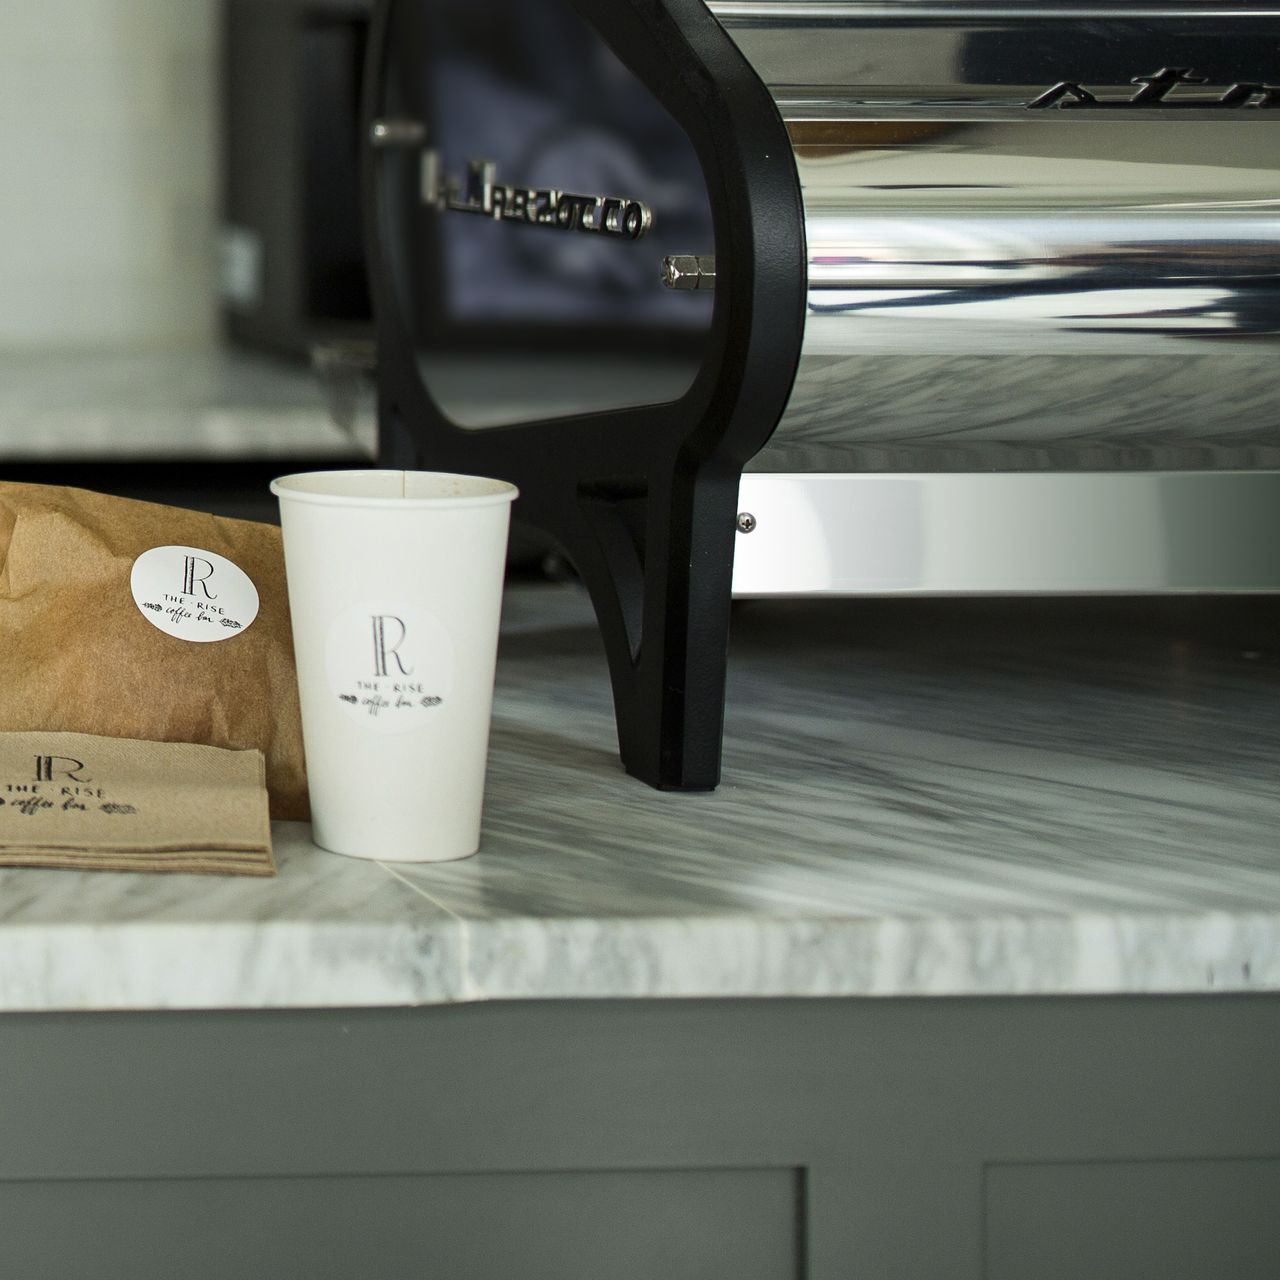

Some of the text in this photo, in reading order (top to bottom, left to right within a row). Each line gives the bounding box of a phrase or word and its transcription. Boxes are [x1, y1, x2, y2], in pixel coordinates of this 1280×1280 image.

[180, 555, 217, 599] R
[163, 593, 225, 615] THE RISE
[165, 606, 192, 624] coffee
[369, 614, 414, 677] R
[32, 754, 93, 783] R
[5, 784, 106, 798] THE RISE
